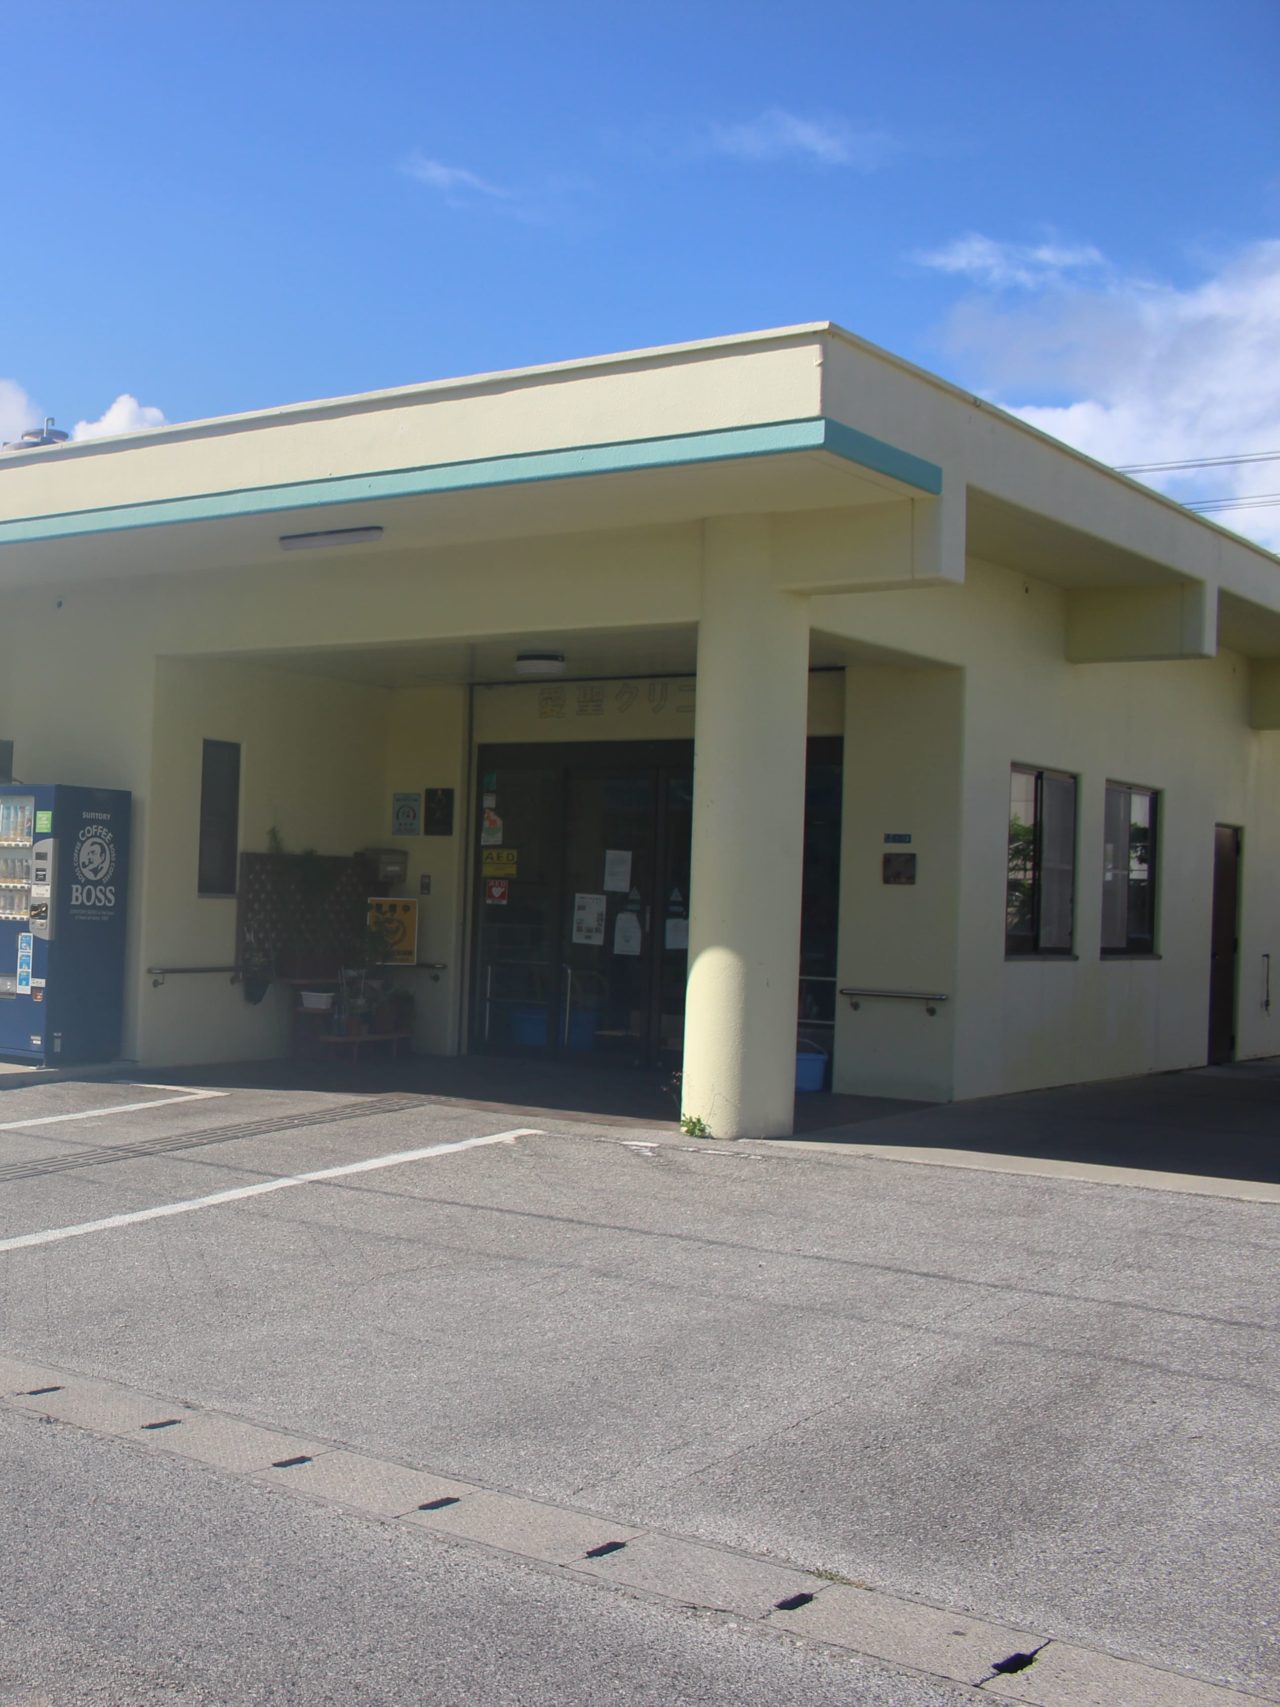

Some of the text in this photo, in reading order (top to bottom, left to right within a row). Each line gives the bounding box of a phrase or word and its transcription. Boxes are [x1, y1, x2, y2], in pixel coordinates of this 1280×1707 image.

[82, 812, 111, 820] SUNTORY
[79, 825, 113, 843] COFFEE
[484, 852, 515, 862] AED
[70, 885, 115, 906] BOSS
